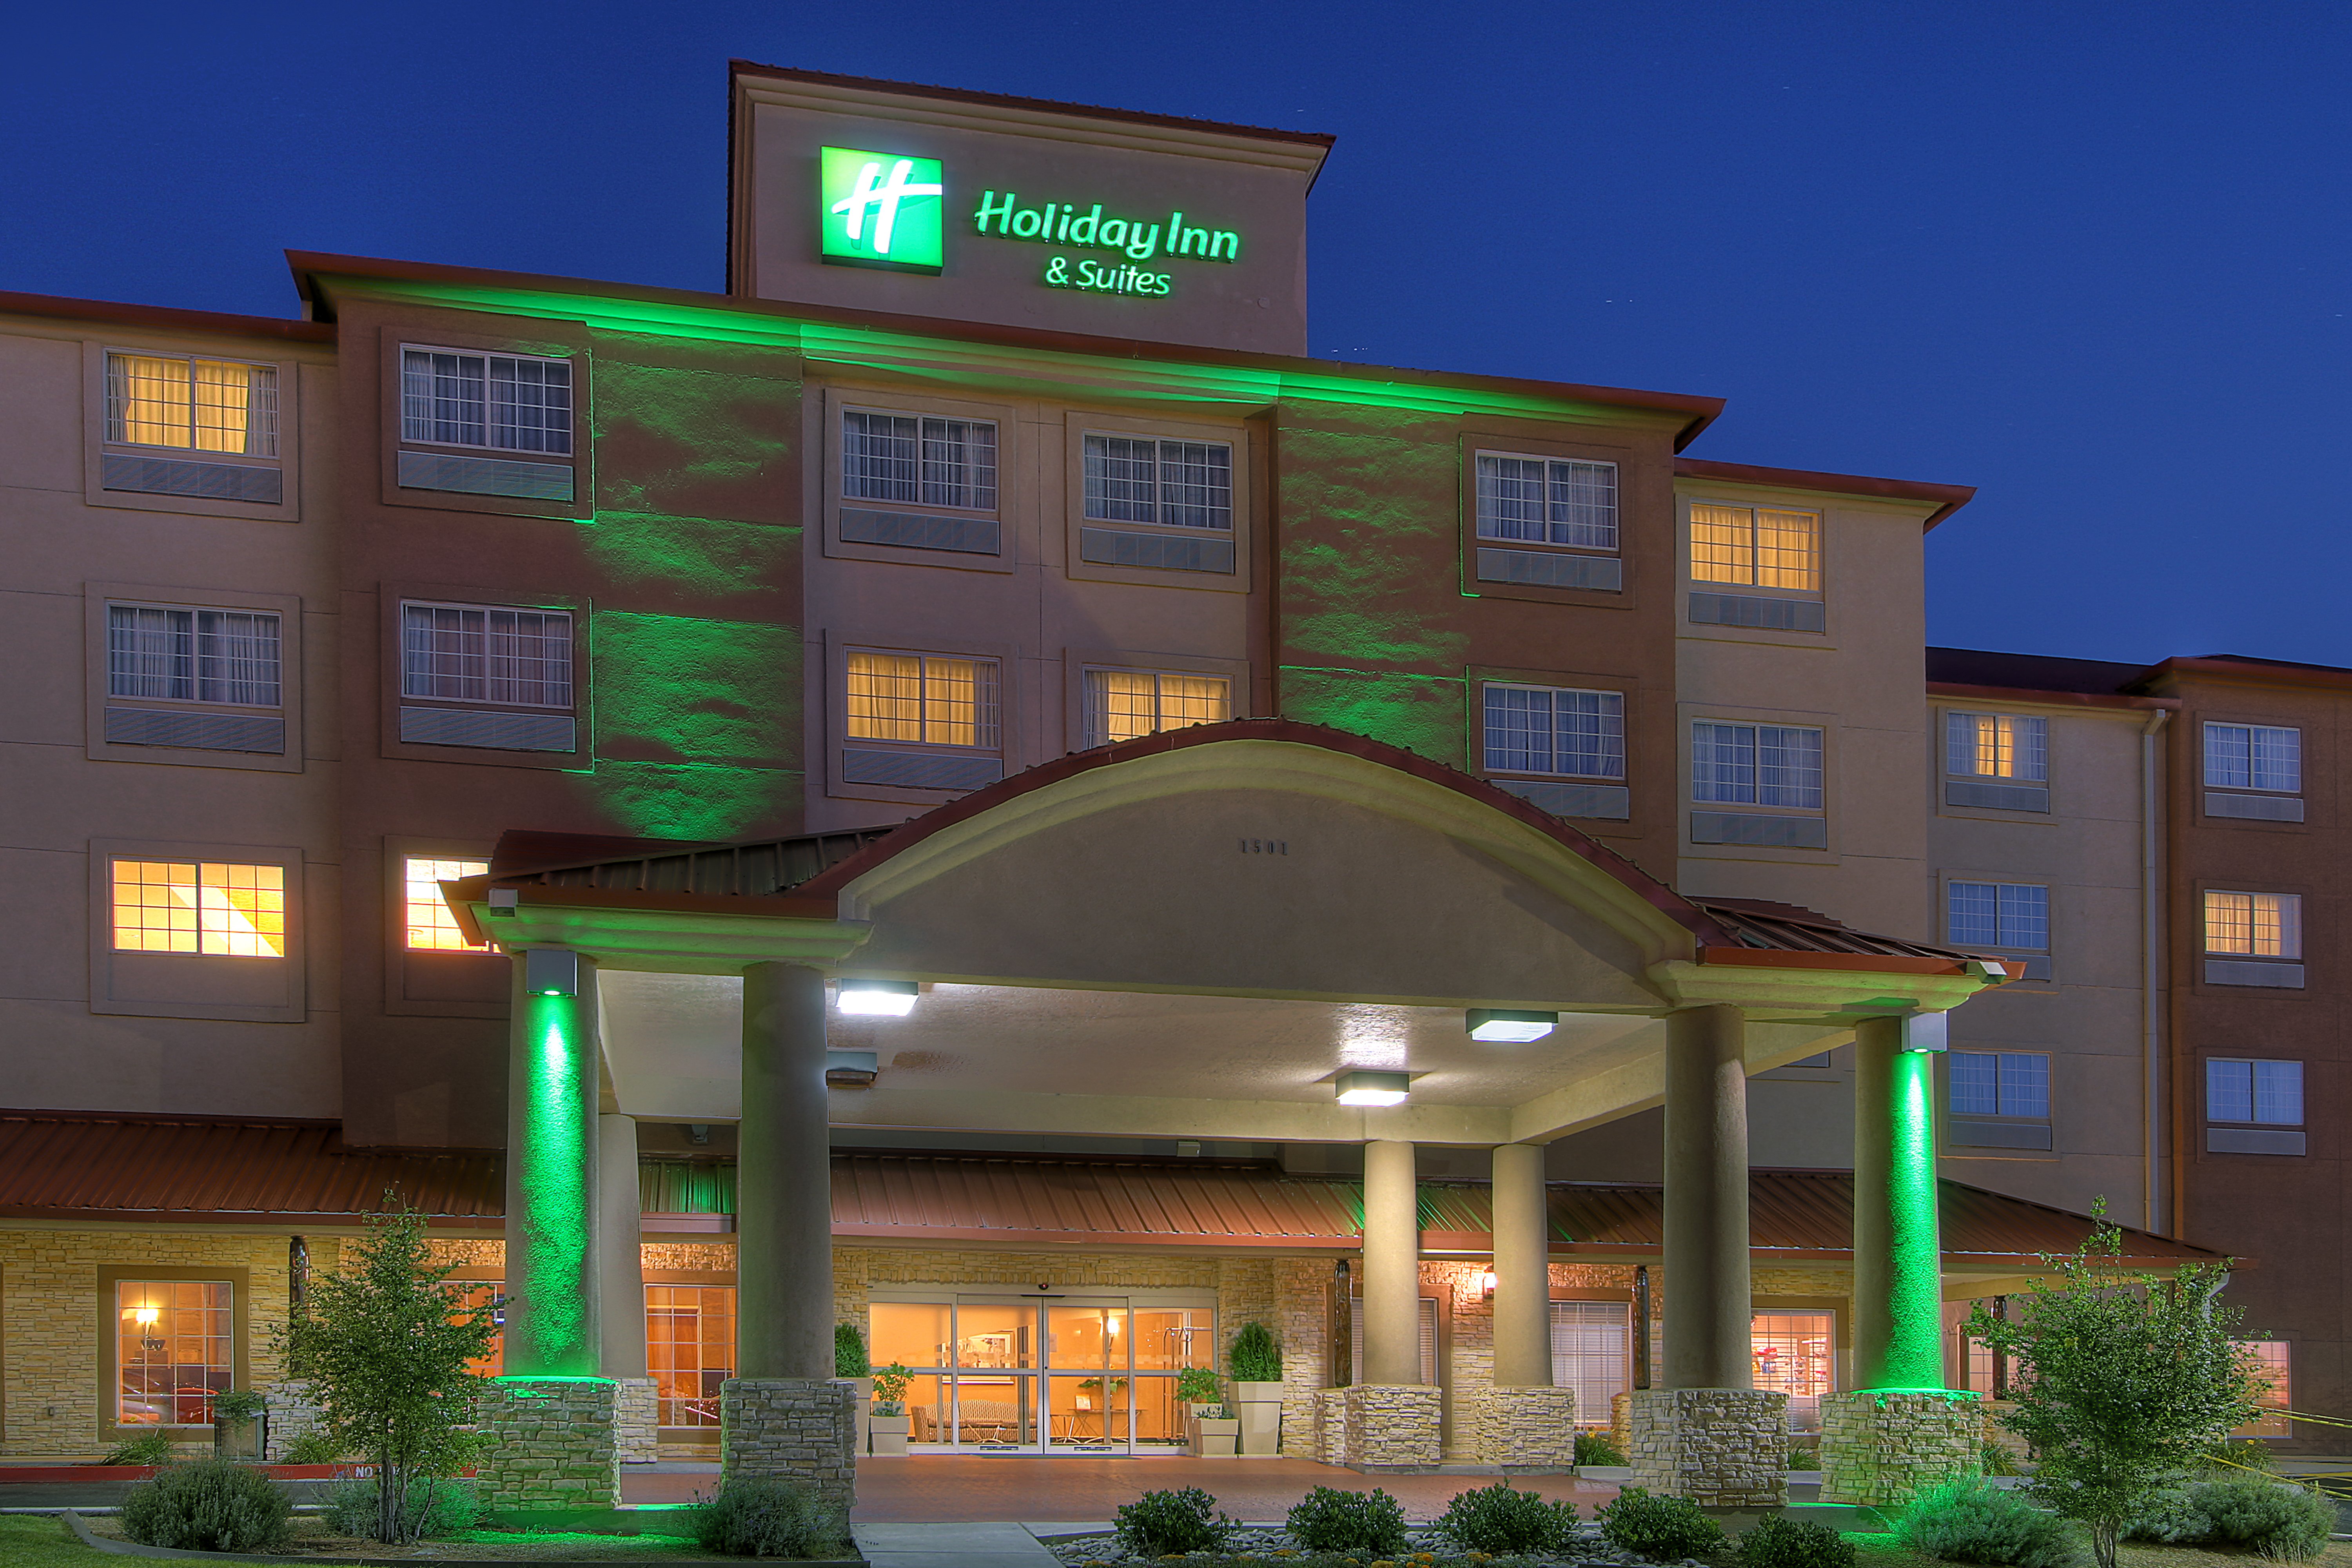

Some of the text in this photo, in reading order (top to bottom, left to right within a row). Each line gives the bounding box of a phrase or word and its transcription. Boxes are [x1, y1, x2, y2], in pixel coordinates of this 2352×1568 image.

[974, 189, 1240, 262] Holiday Inn
[1045, 256, 1172, 296] & Suites
[1242, 840, 1287, 856] 1501
[355, 1466, 373, 1478] NO
